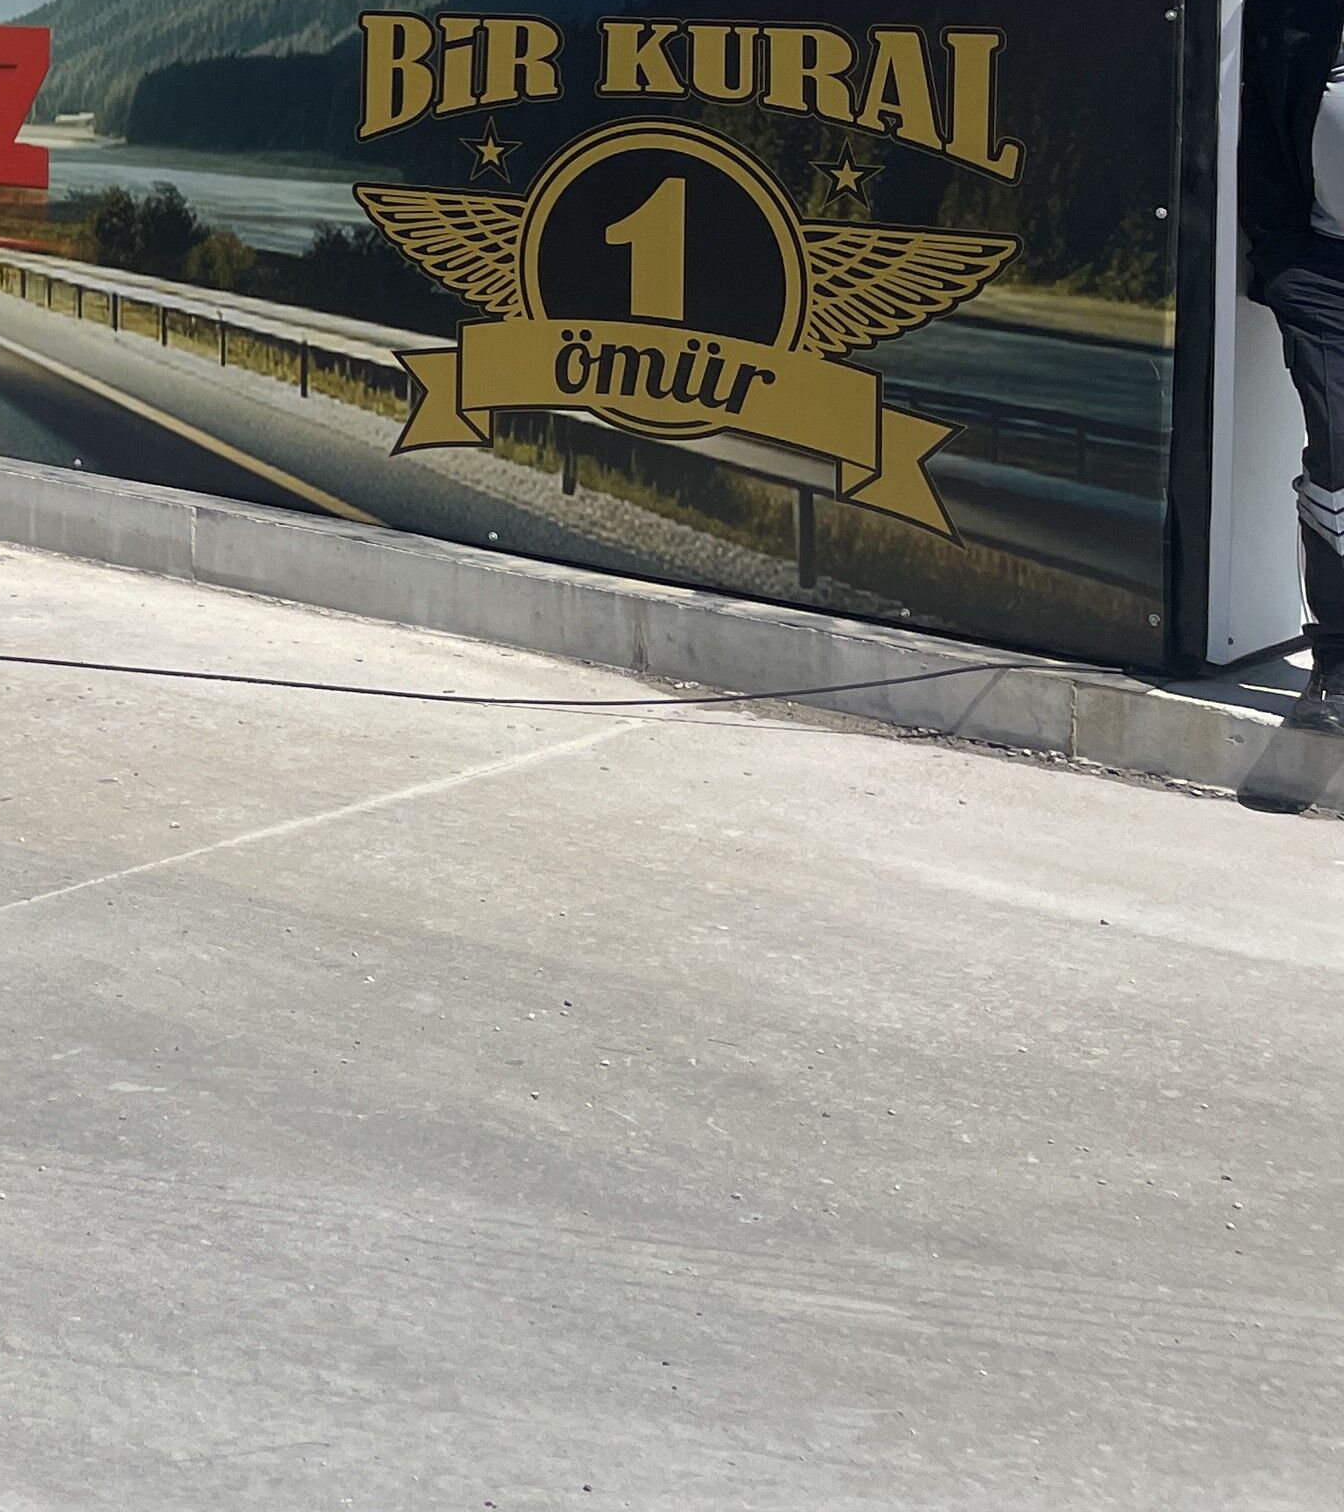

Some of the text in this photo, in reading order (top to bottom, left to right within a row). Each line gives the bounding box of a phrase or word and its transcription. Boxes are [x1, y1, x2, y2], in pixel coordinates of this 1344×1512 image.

[598, 21, 1018, 181] KURAL
[604, 177, 686, 322] 1
[554, 329, 776, 414] ömür
